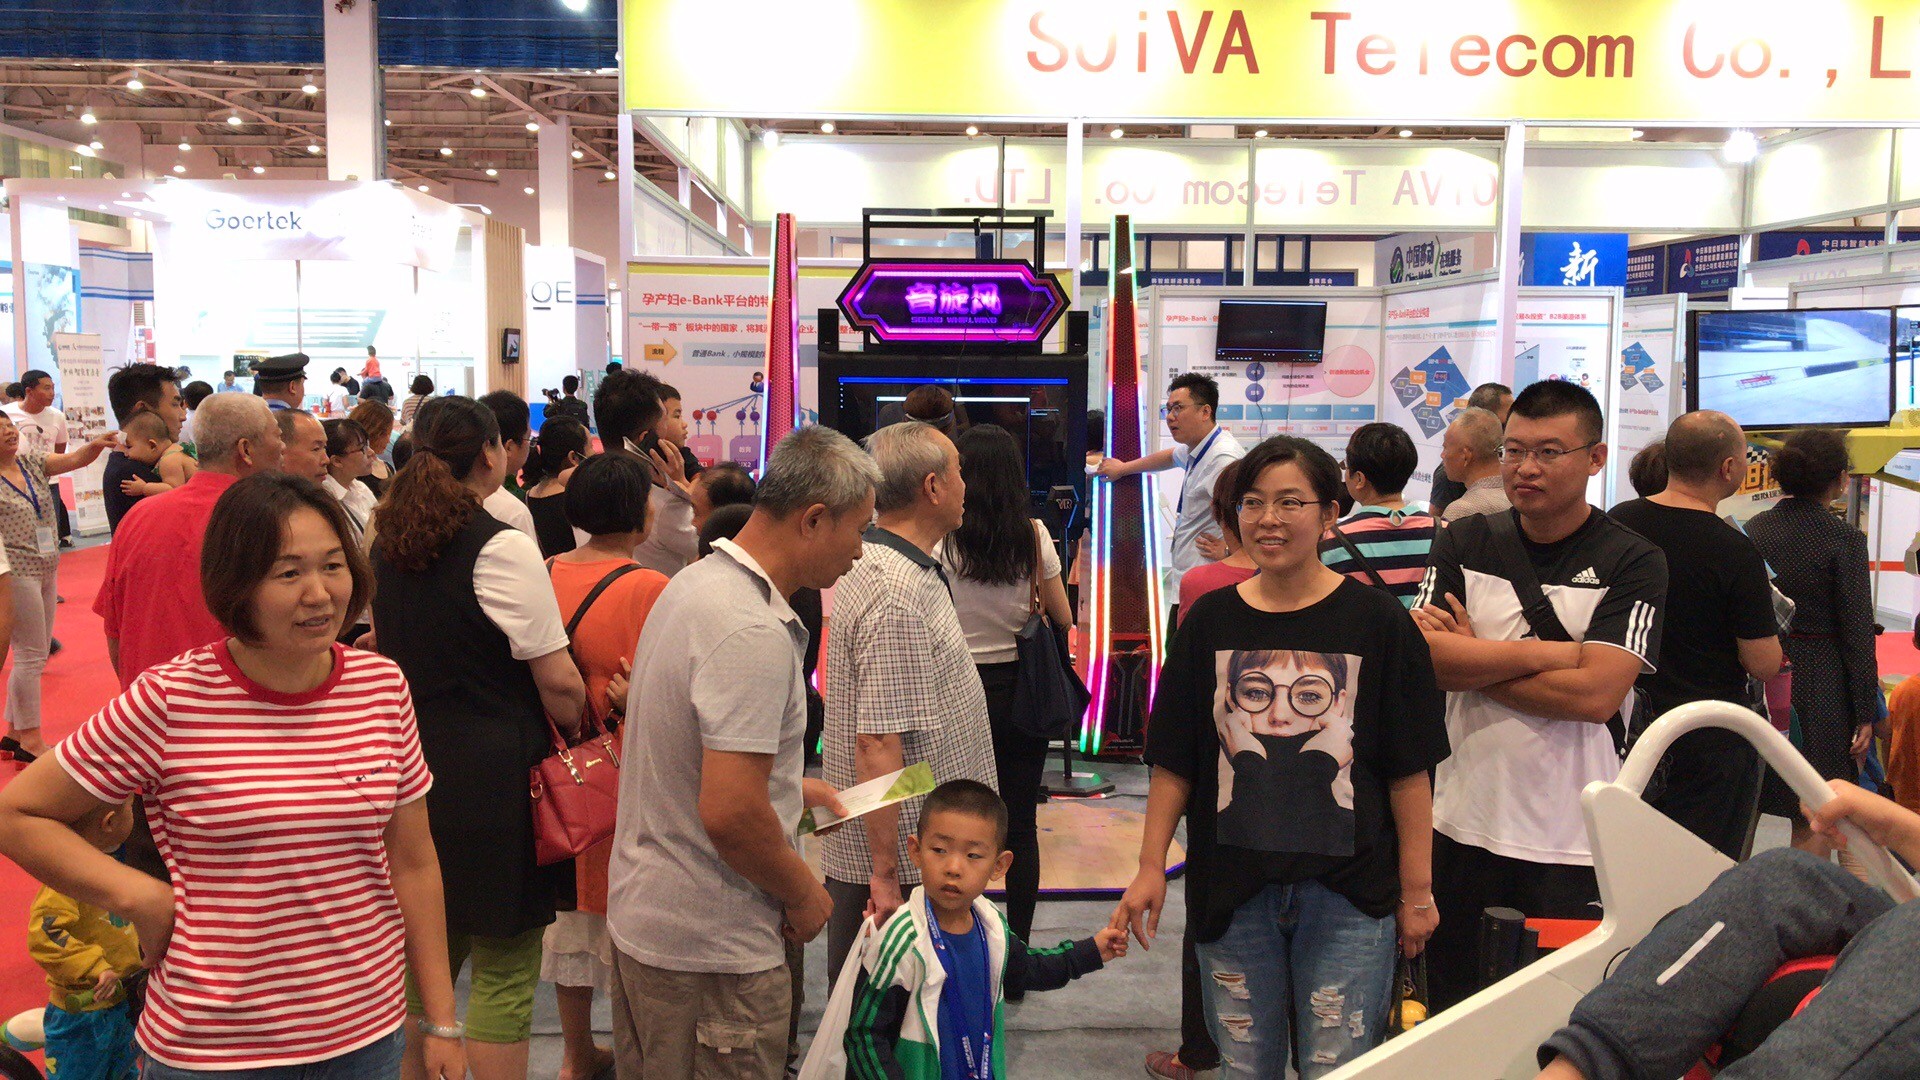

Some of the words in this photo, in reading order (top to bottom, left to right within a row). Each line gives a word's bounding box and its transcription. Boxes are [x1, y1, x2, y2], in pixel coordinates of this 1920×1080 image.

[1311, 11, 1635, 79] Telecom
[205, 209, 302, 230] Goertek
[530, 281, 573, 303] OE
[1571, 576, 1600, 585] adidas
